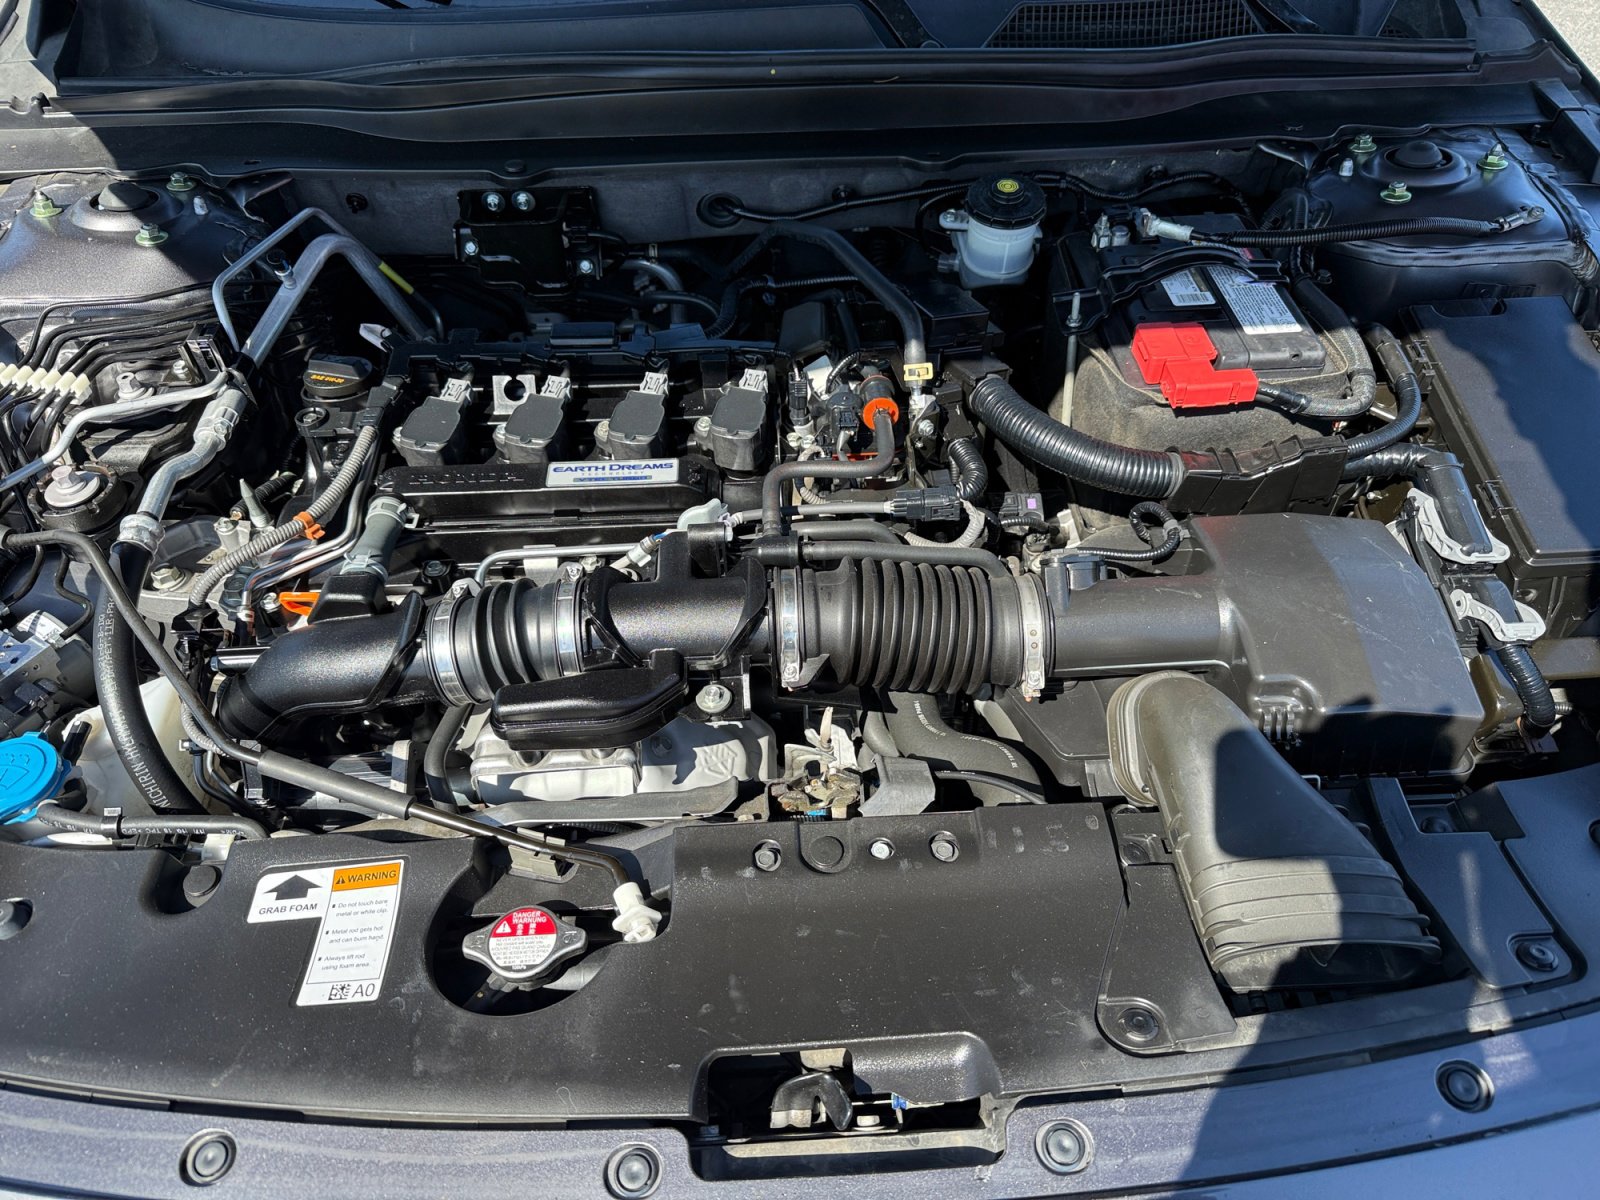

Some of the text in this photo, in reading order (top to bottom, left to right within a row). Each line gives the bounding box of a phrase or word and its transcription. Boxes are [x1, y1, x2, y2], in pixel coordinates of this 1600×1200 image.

[553, 463, 674, 473] EARTH DREAMS
[131, 761, 171, 808] NICHIRIN
[347, 870, 397, 883] WARNING
[259, 903, 318, 915] GRAB FOAM
[512, 916, 547, 924] WARNUNG
